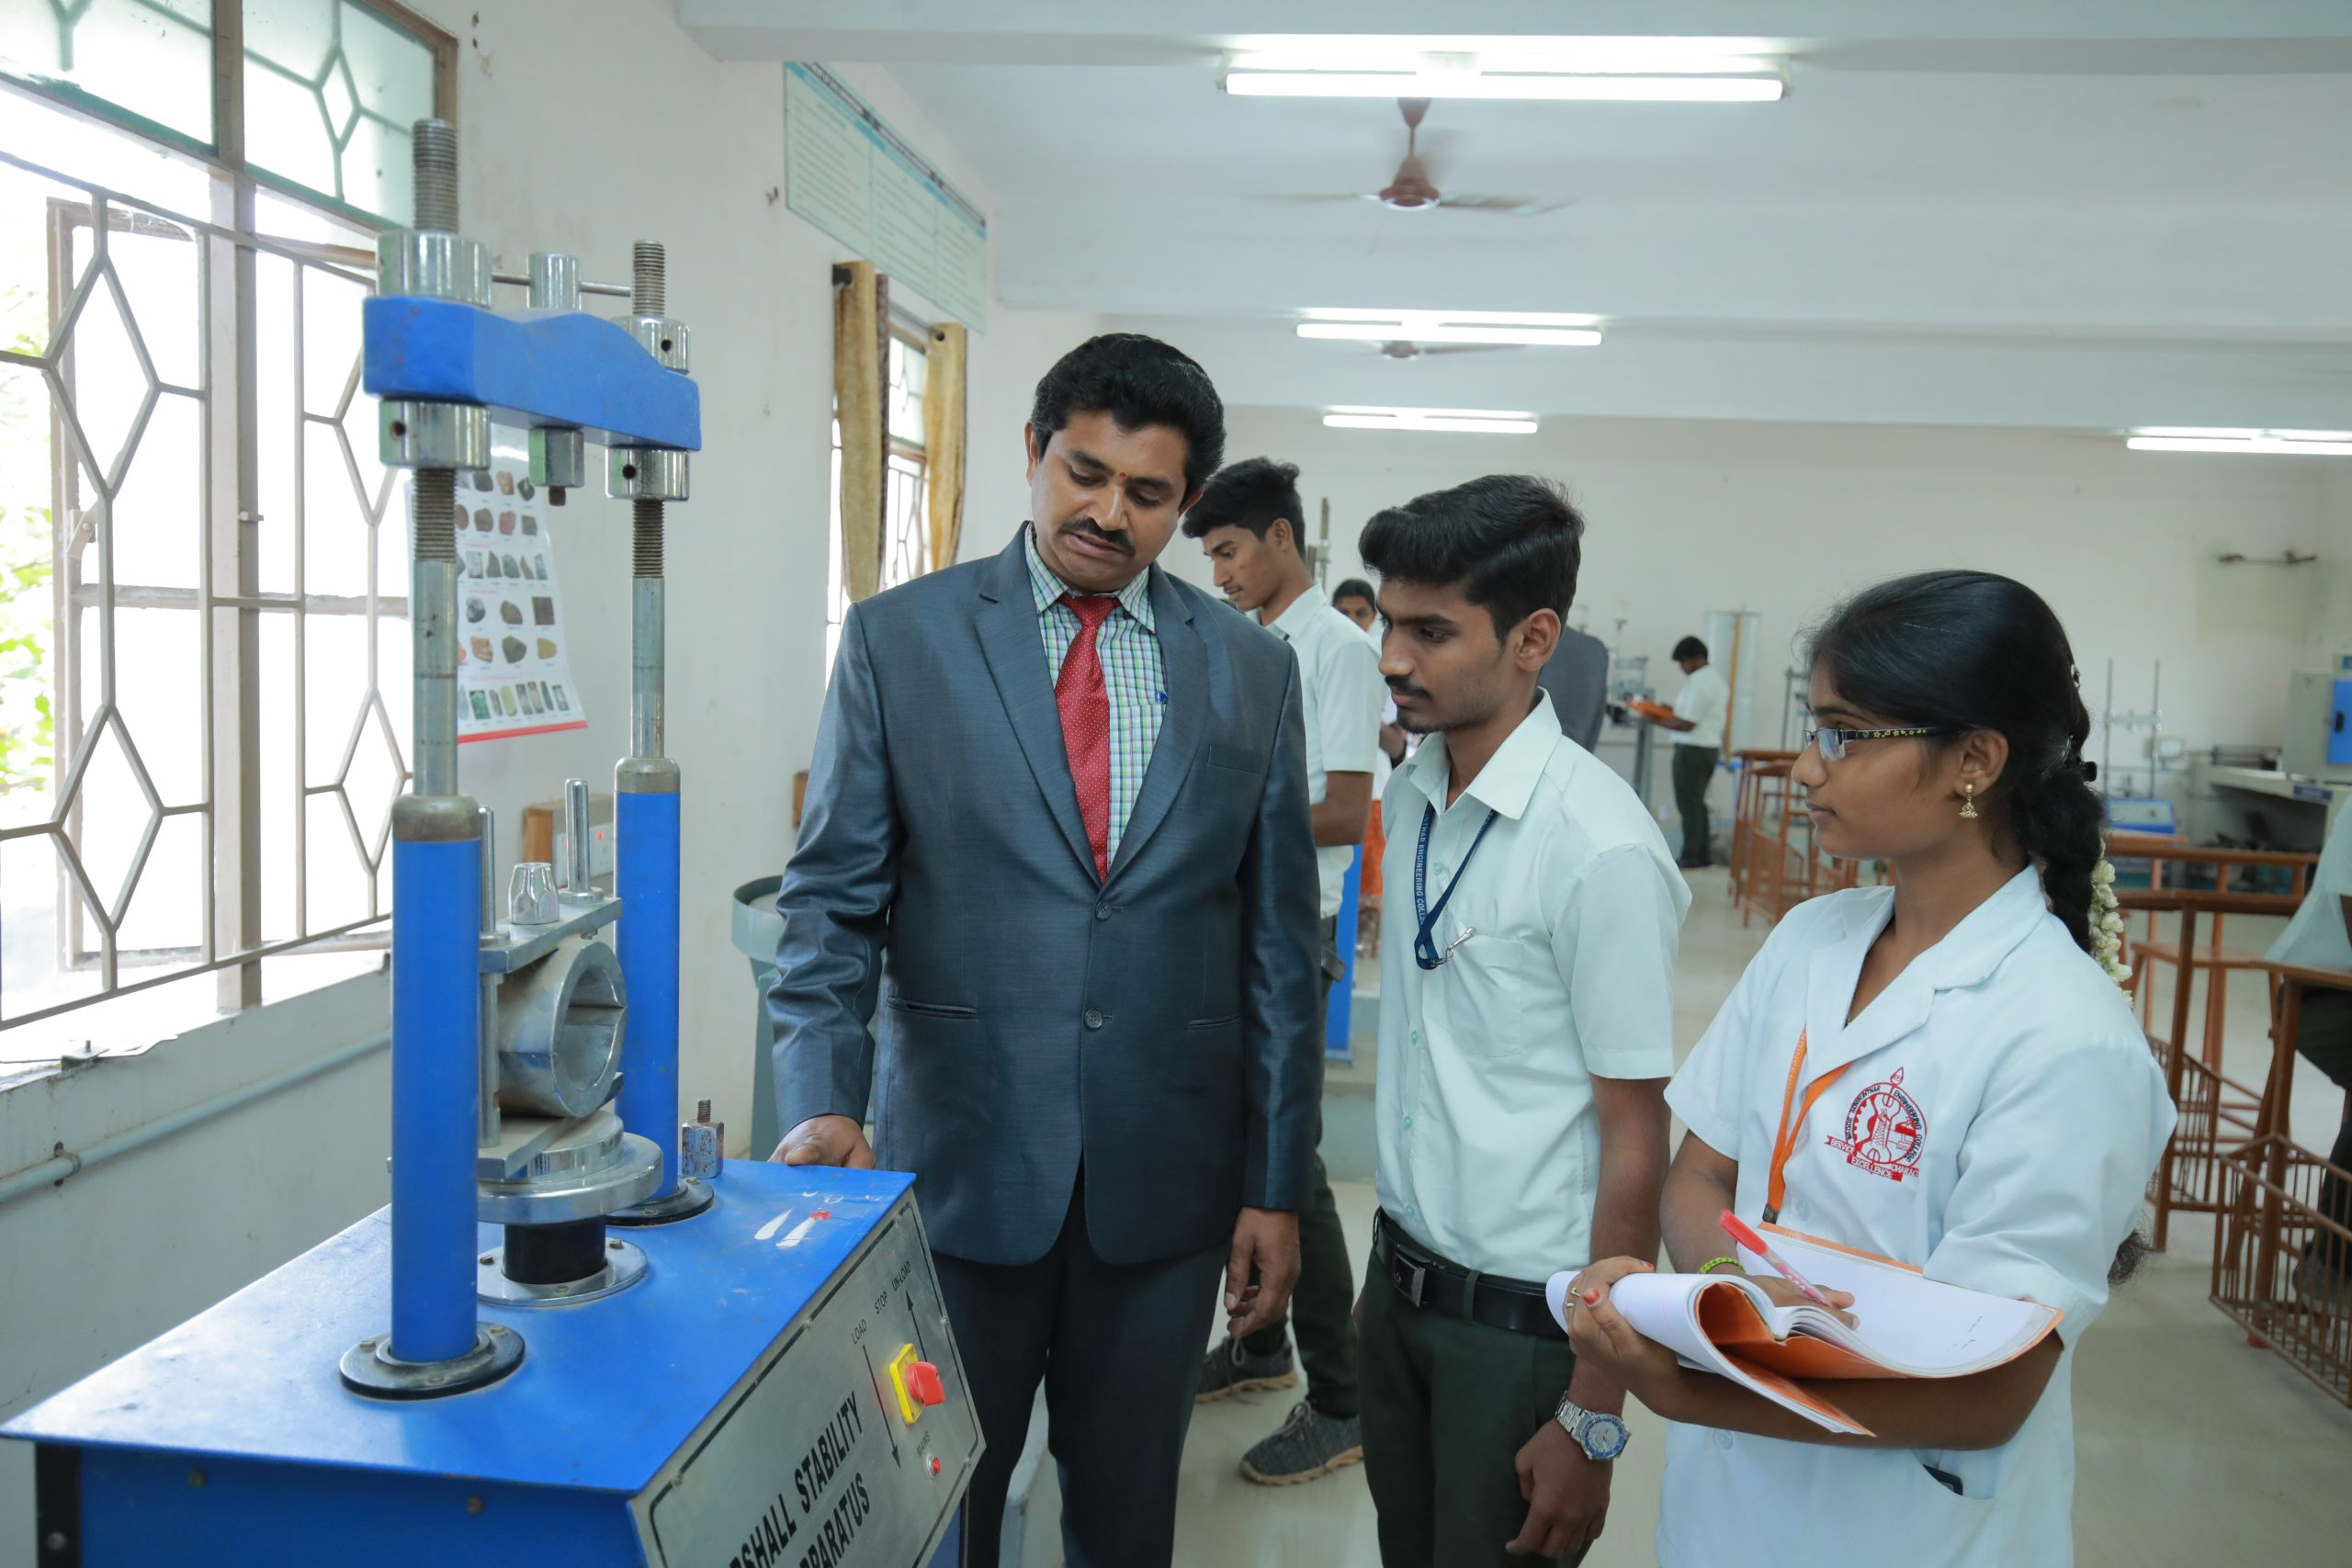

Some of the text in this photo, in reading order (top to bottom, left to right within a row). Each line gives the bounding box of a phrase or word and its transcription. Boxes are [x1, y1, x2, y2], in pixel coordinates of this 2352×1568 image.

[1415, 844, 1425, 897] ENGINEERING
[1416, 898, 1427, 925] COLLE
[1851, 1156, 1894, 1178] EXCELLENCE
[851, 1318, 867, 1345] LOAD
[874, 1291, 888, 1314] STOP
[795, 1391, 864, 1514] STABILITY
